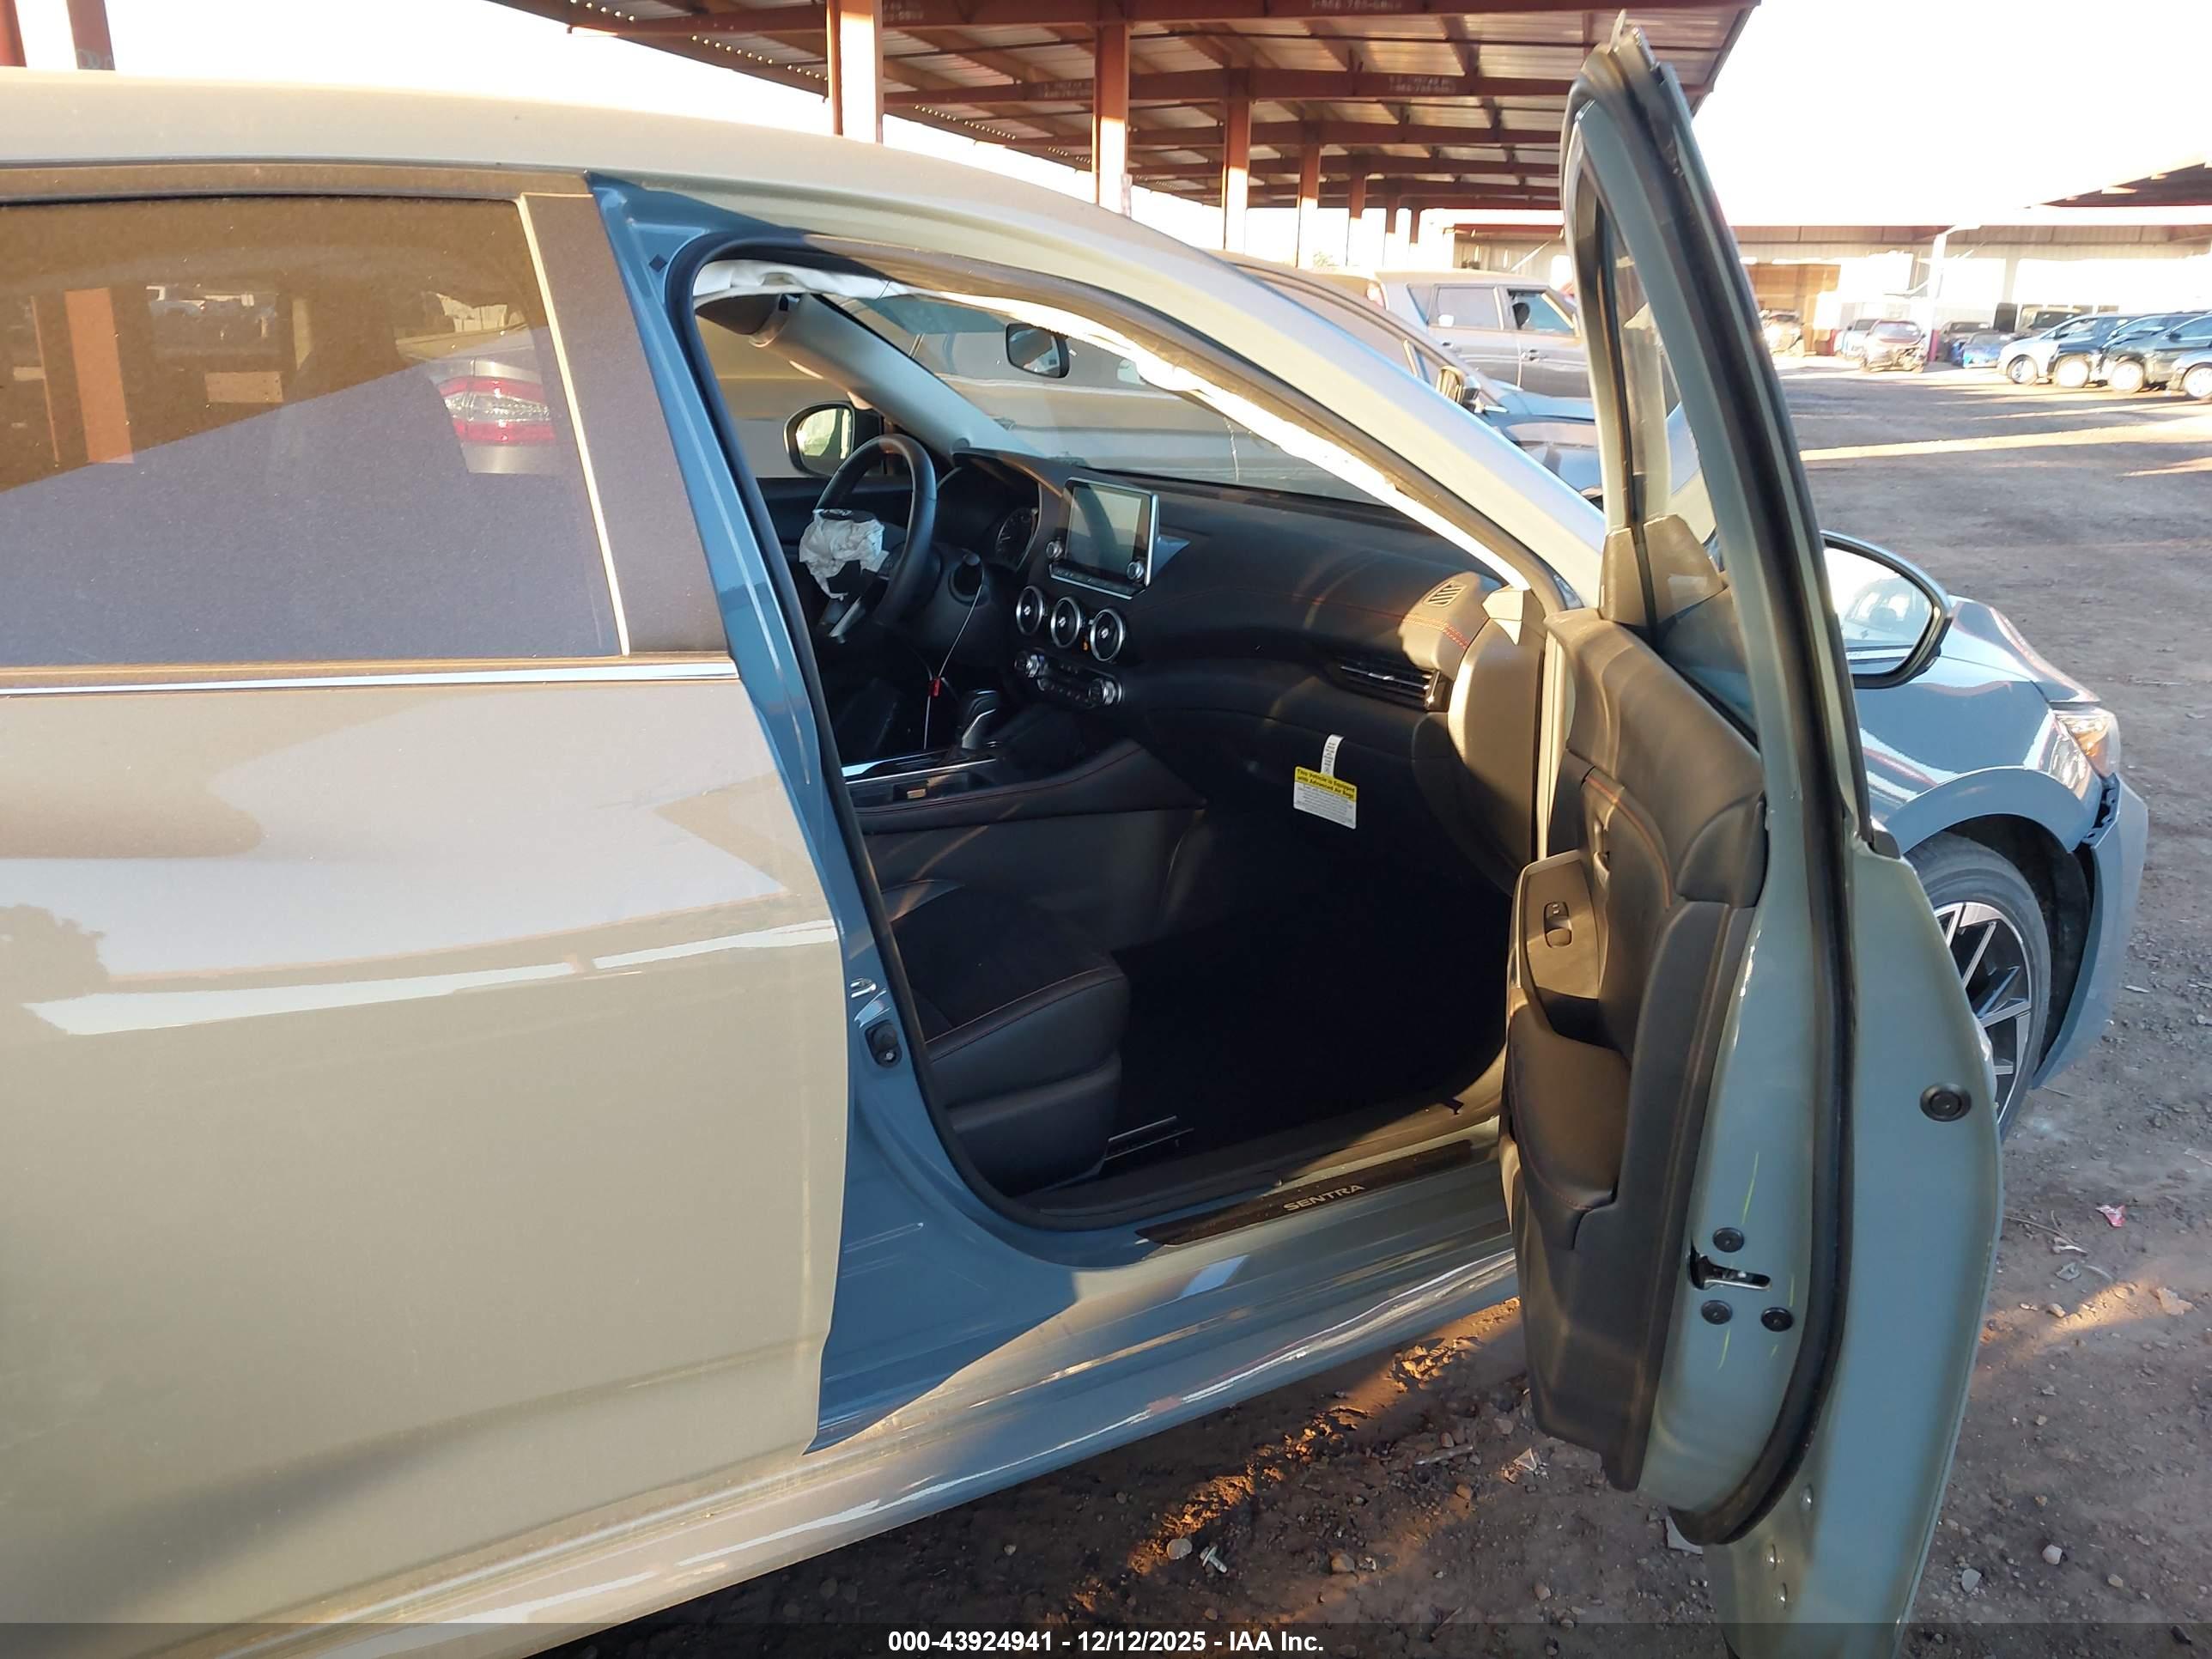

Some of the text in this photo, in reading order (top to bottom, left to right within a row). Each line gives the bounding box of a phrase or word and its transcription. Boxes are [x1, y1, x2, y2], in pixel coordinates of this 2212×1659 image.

[1297, 768, 1308, 776] This
[1310, 773, 1327, 781] Vehicle
[1310, 778, 1334, 790] Advanced
[1283, 1184, 1365, 1211] SENTRA
